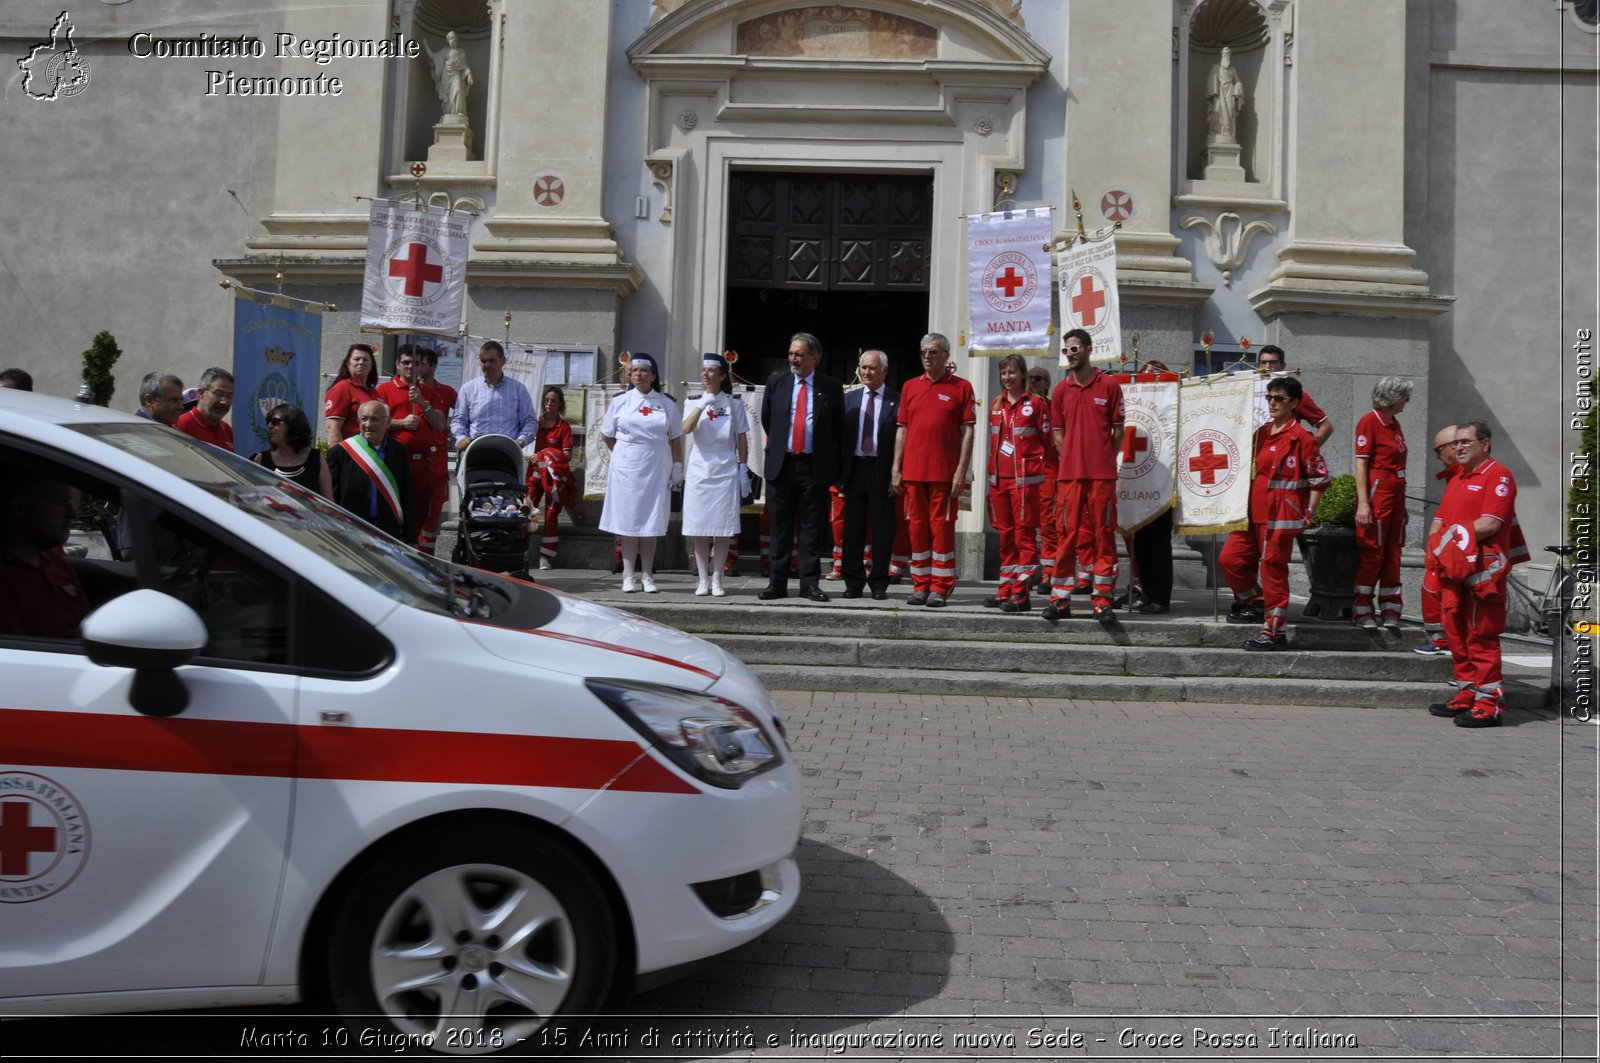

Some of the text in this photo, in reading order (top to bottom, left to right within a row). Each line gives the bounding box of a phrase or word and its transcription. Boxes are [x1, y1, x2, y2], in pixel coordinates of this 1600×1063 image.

[402, 224, 430, 235] ROSSA
[378, 305, 446, 320] DELEGAZIONE DI
[381, 314, 442, 328] PEVERAGNO
[987, 320, 1032, 333] MANTA
[1124, 397, 1143, 407] SSA
[1221, 436, 1231, 446] 22
[36, 782, 86, 854] ITALIANA
